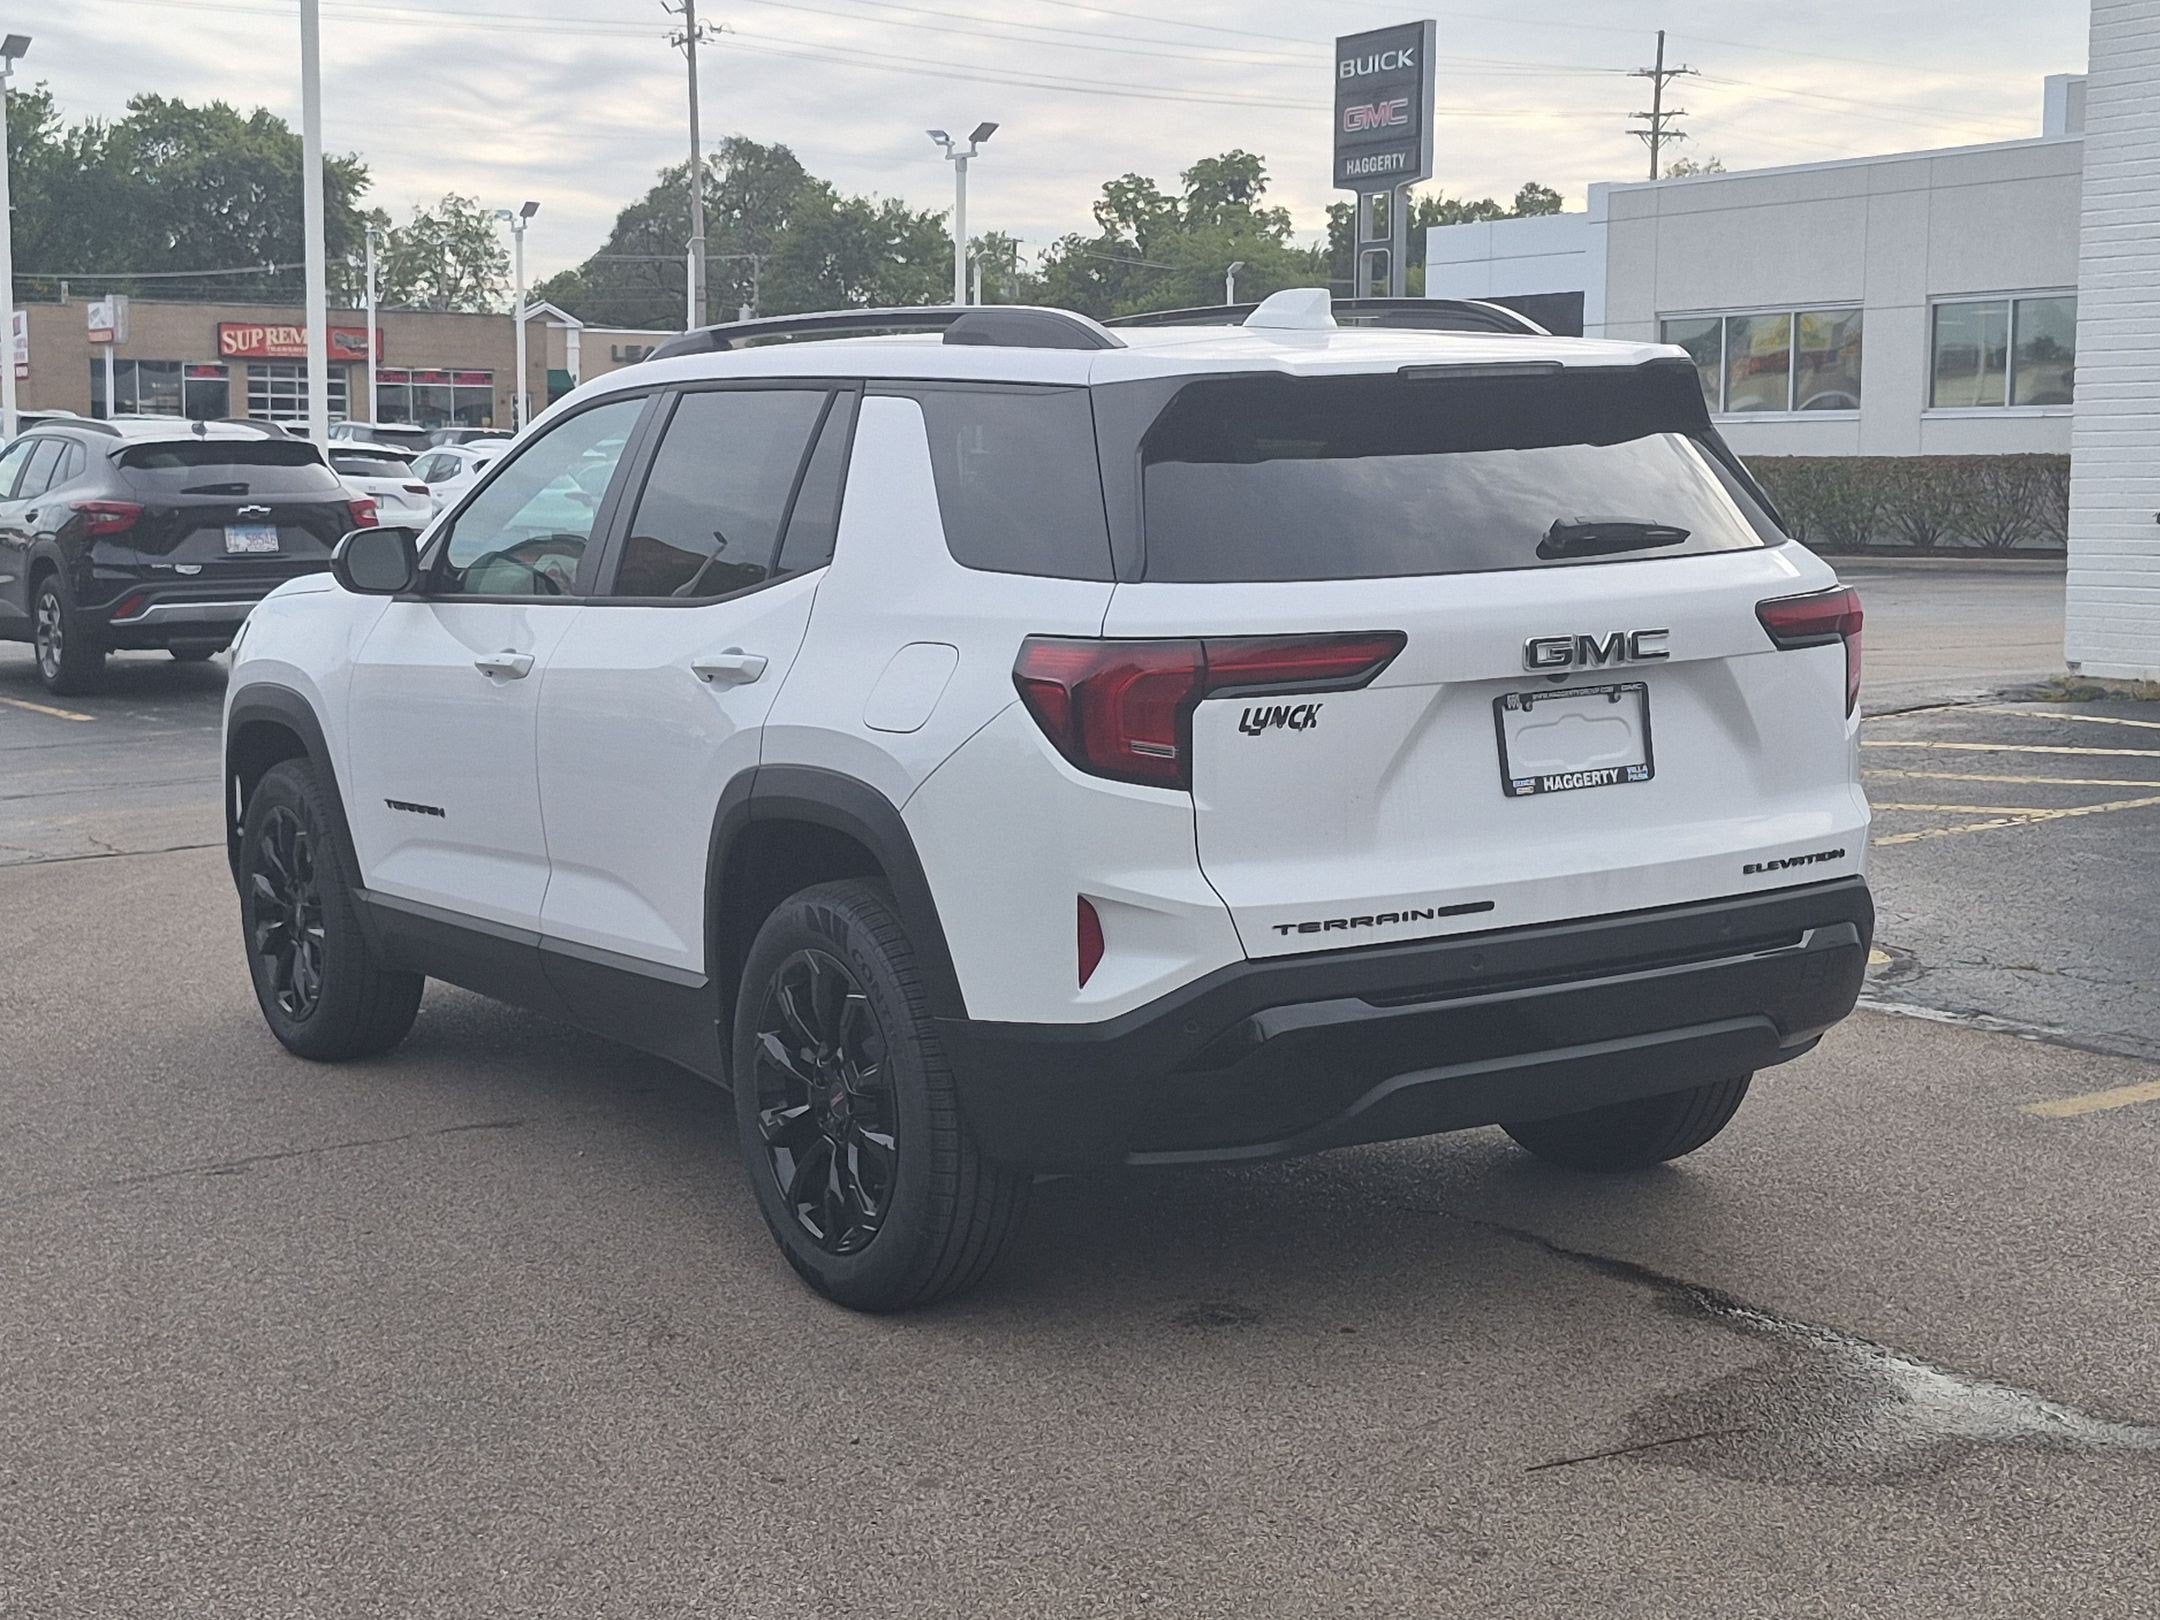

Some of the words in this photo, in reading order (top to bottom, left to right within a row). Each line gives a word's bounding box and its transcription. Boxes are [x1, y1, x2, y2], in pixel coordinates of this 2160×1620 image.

[1339, 47, 1416, 79] BUICK
[1343, 97, 1408, 132] GMC
[1346, 152, 1406, 175] HAGGERTY
[222, 326, 308, 354] SUPREM
[1523, 627, 1670, 672] GMC
[1543, 768, 1619, 792] HAGGERTY
[1742, 847, 1846, 875] ELEVATION
[1271, 908, 1434, 936] TERRAIN
